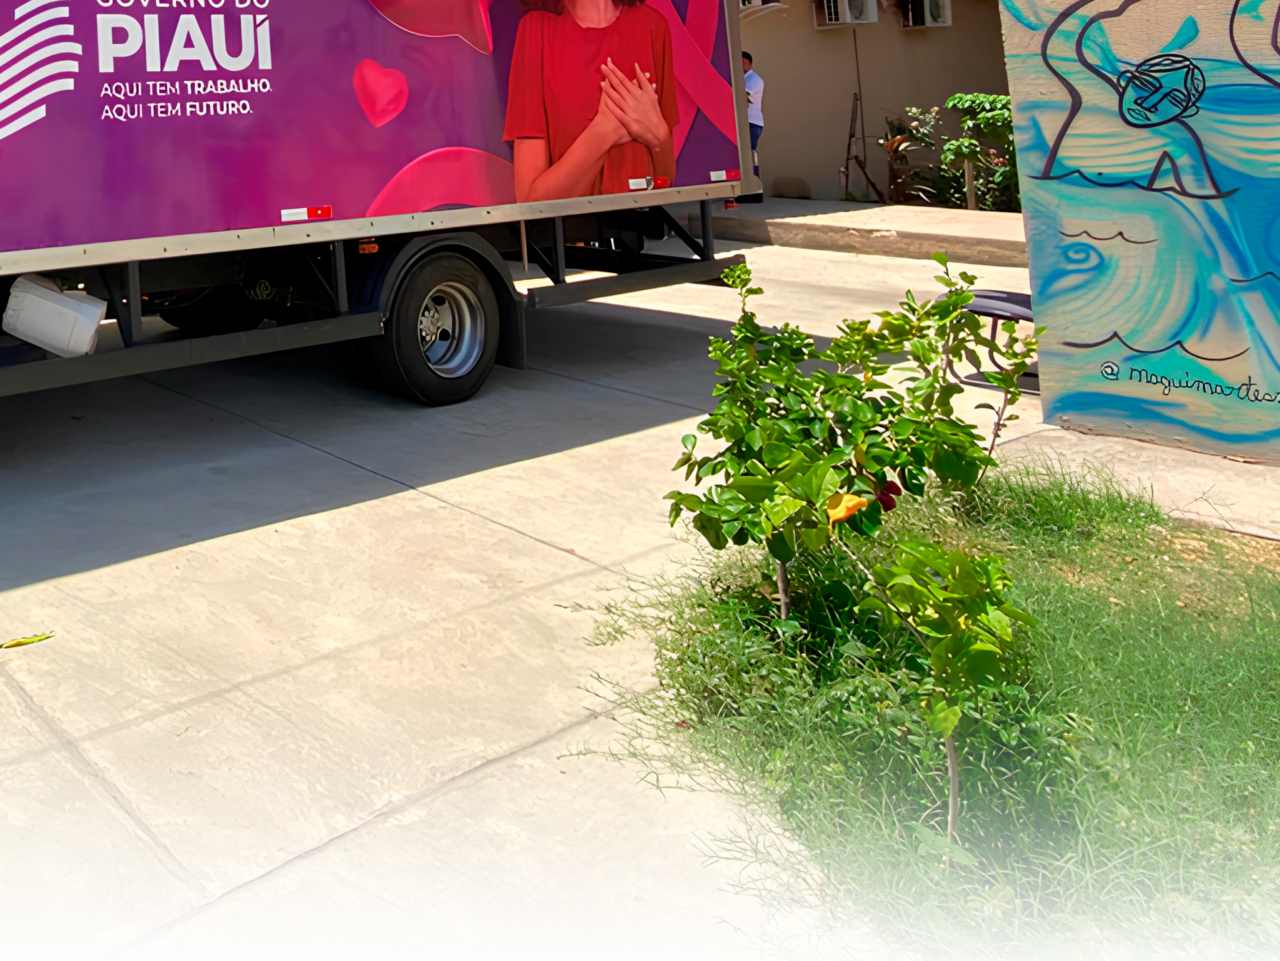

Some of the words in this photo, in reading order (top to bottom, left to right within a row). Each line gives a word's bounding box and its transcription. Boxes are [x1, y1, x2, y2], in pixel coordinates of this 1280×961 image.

[95, 13, 272, 73] PIAUÍ
[100, 81, 142, 99] AQUI
[146, 81, 180, 96] TEM
[101, 104, 143, 121] AQUI
[147, 102, 181, 118] TEM
